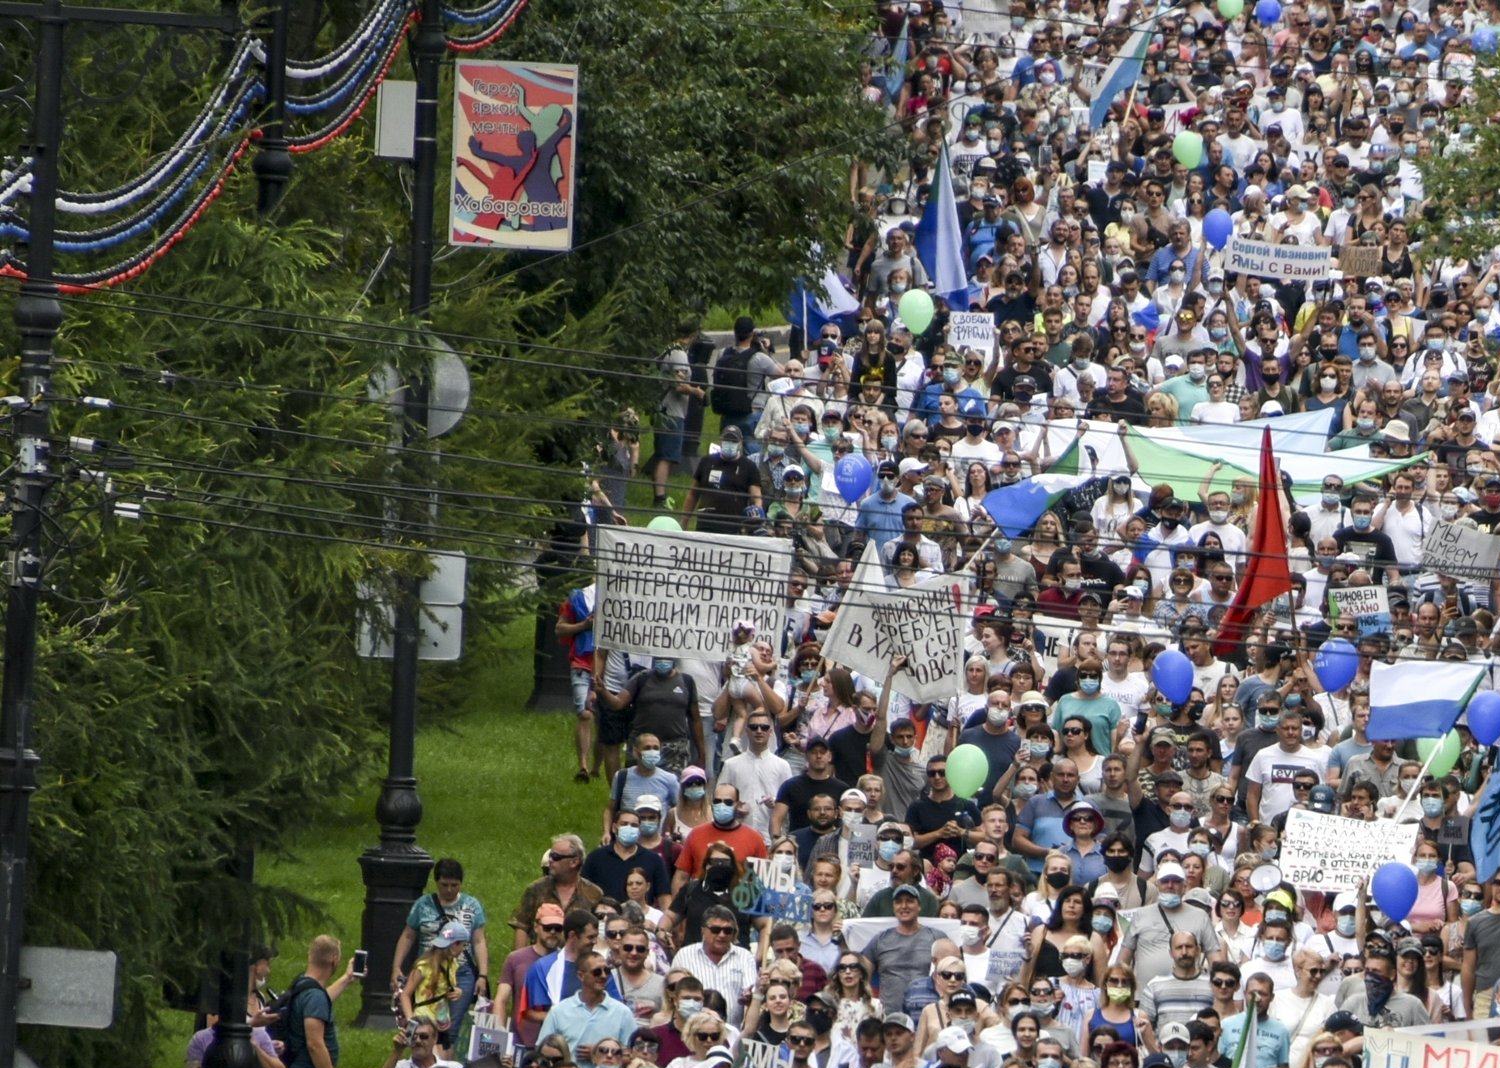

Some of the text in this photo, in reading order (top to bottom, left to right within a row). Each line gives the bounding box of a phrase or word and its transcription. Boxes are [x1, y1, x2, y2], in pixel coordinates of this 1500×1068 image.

[473, 79, 520, 98] Город
[472, 104, 519, 115] яркой
[471, 121, 519, 135] мечты
[455, 193, 567, 219] Хабаровск!
[1232, 240, 1270, 258] Сергей
[1274, 246, 1329, 261] Иванович
[1283, 264, 1326, 277] Вами!
[1432, 519, 1464, 545] МЫ
[606, 567, 786, 607] ИНТЕРЕСОВ НАРОДА
[707, 604, 779, 632] ПАРТИЮ
